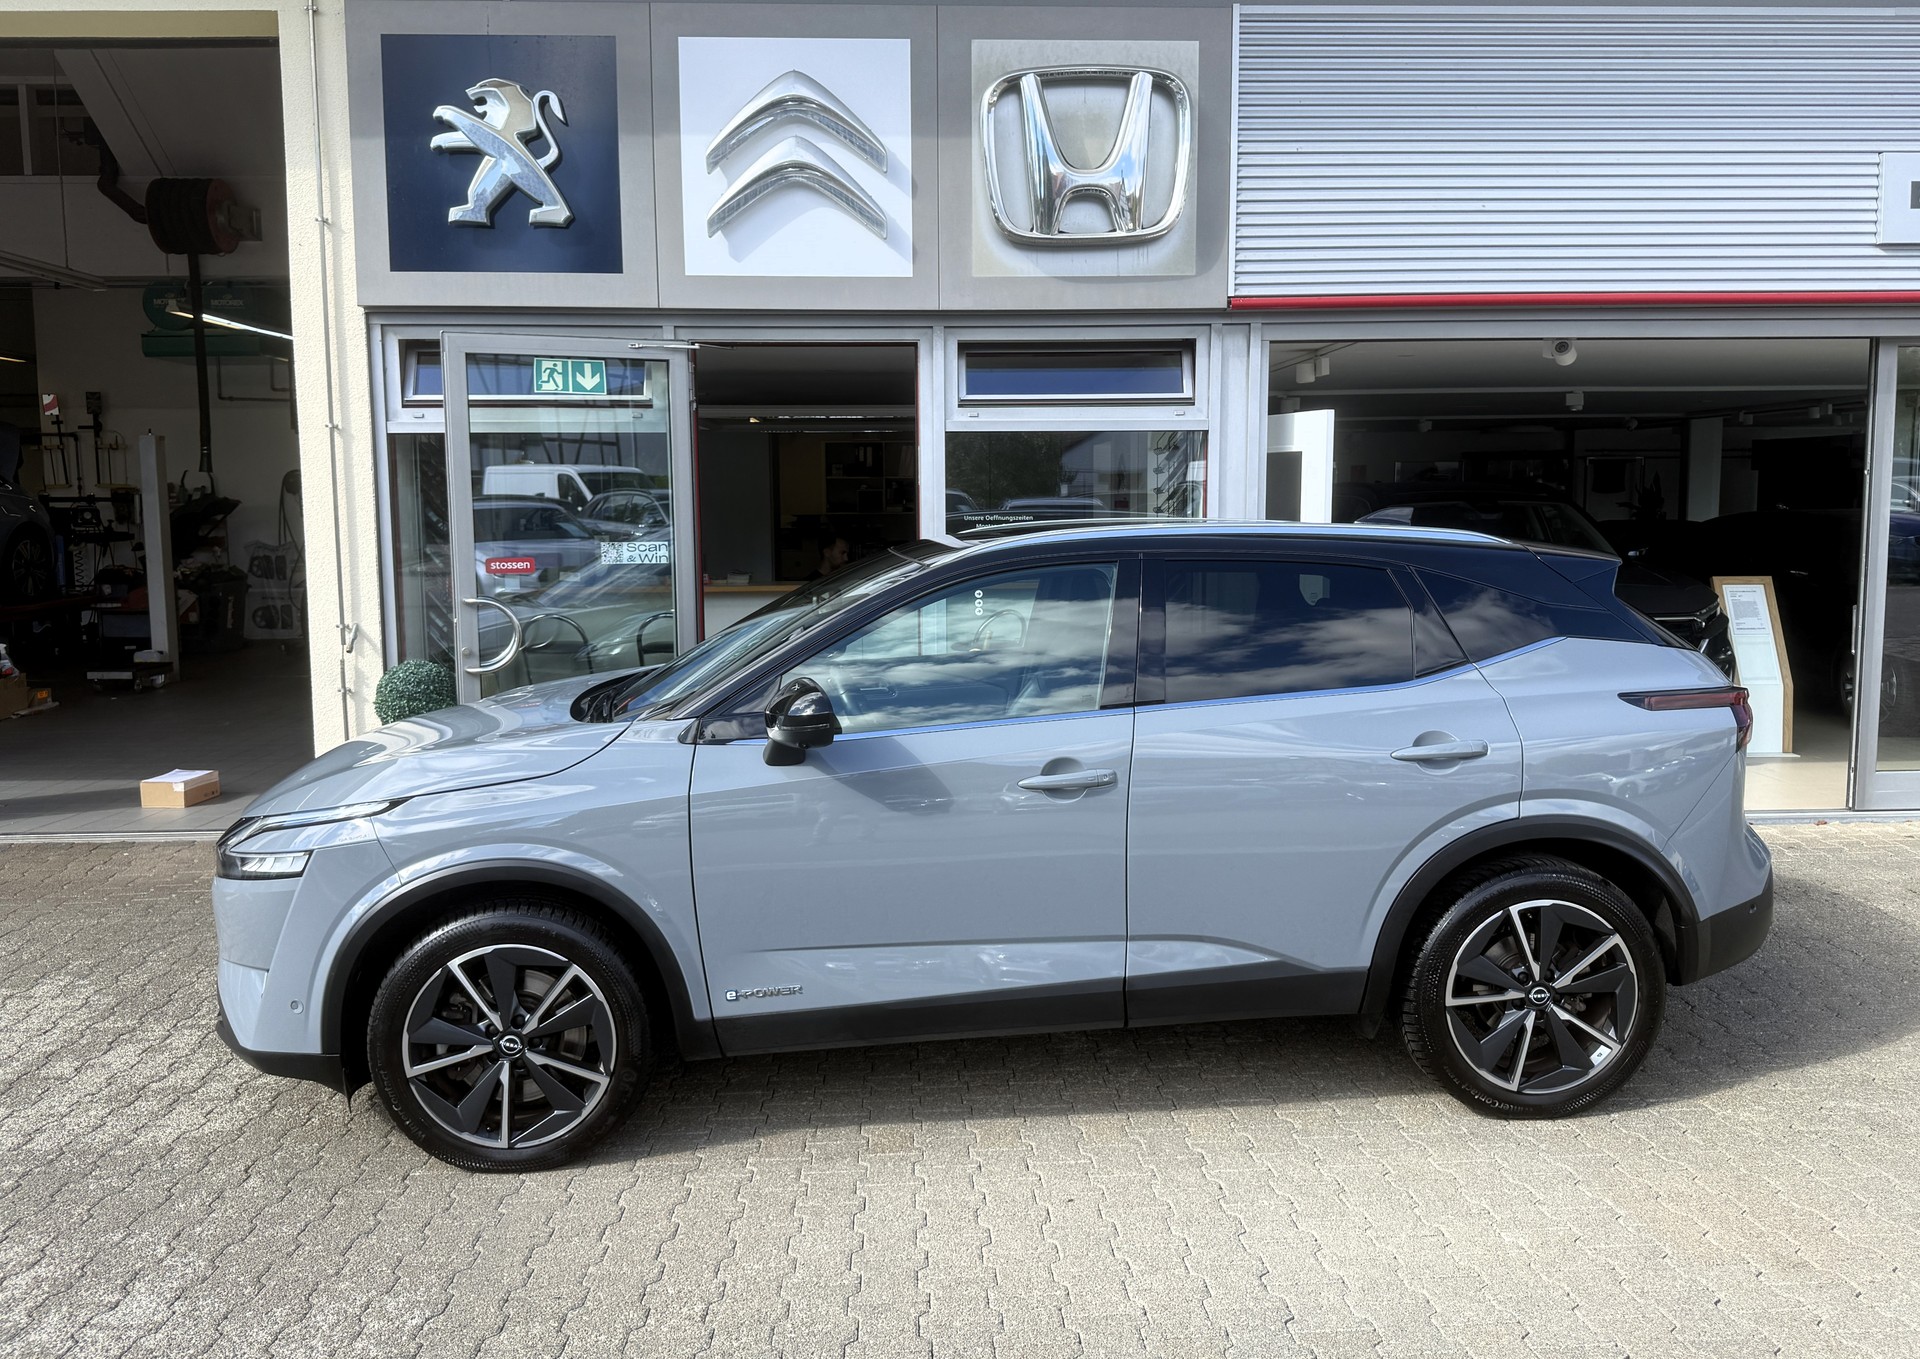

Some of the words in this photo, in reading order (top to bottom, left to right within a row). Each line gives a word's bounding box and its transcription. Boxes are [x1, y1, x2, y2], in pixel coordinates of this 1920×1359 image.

[626, 542, 668, 552] Scan
[626, 555, 637, 563] &
[638, 553, 669, 563] Win
[490, 559, 531, 570] stossen
[725, 984, 804, 1001] e-POWER
